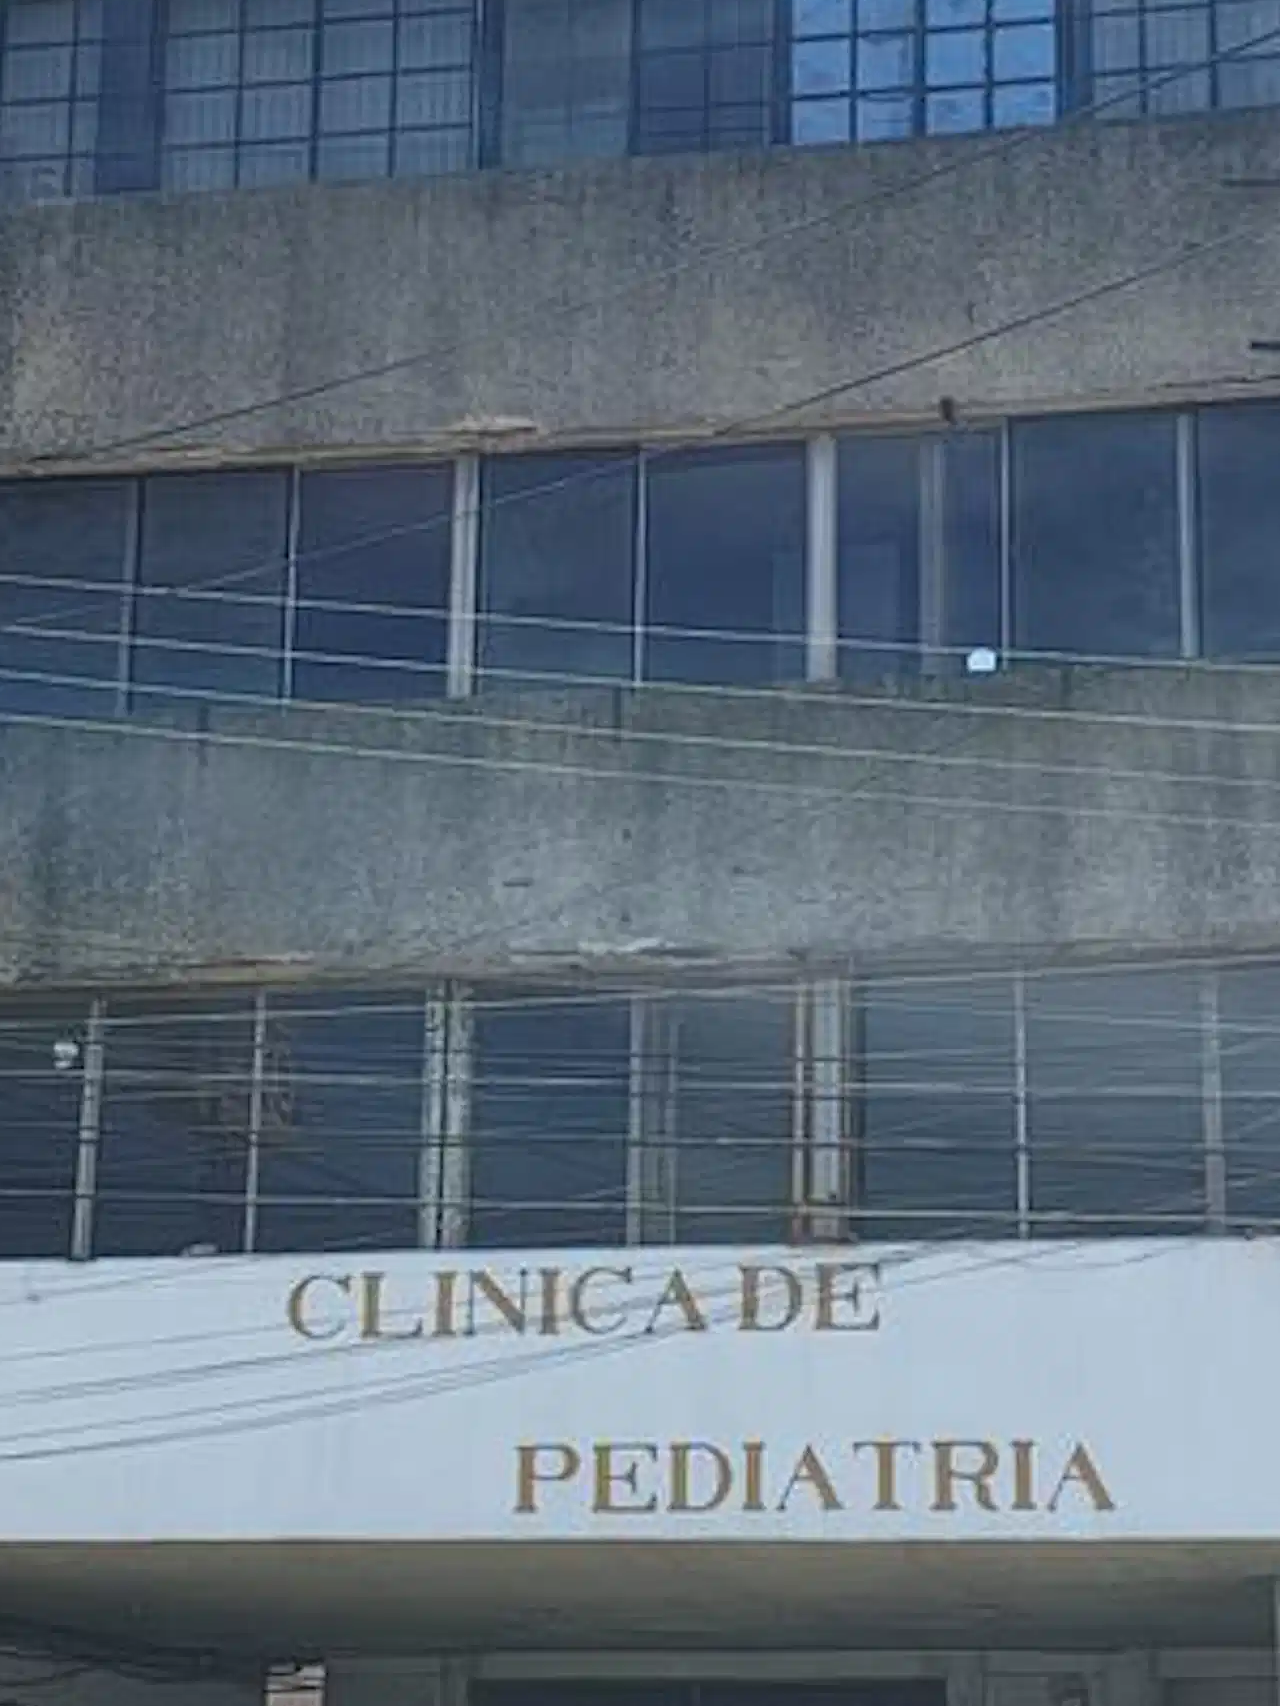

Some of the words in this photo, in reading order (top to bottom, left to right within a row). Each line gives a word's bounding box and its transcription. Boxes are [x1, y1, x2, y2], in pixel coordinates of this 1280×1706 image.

[286, 1266, 708, 1339] CLINICA
[737, 1262, 884, 1333] DE
[513, 1440, 1116, 1514] PEDIATRIA
